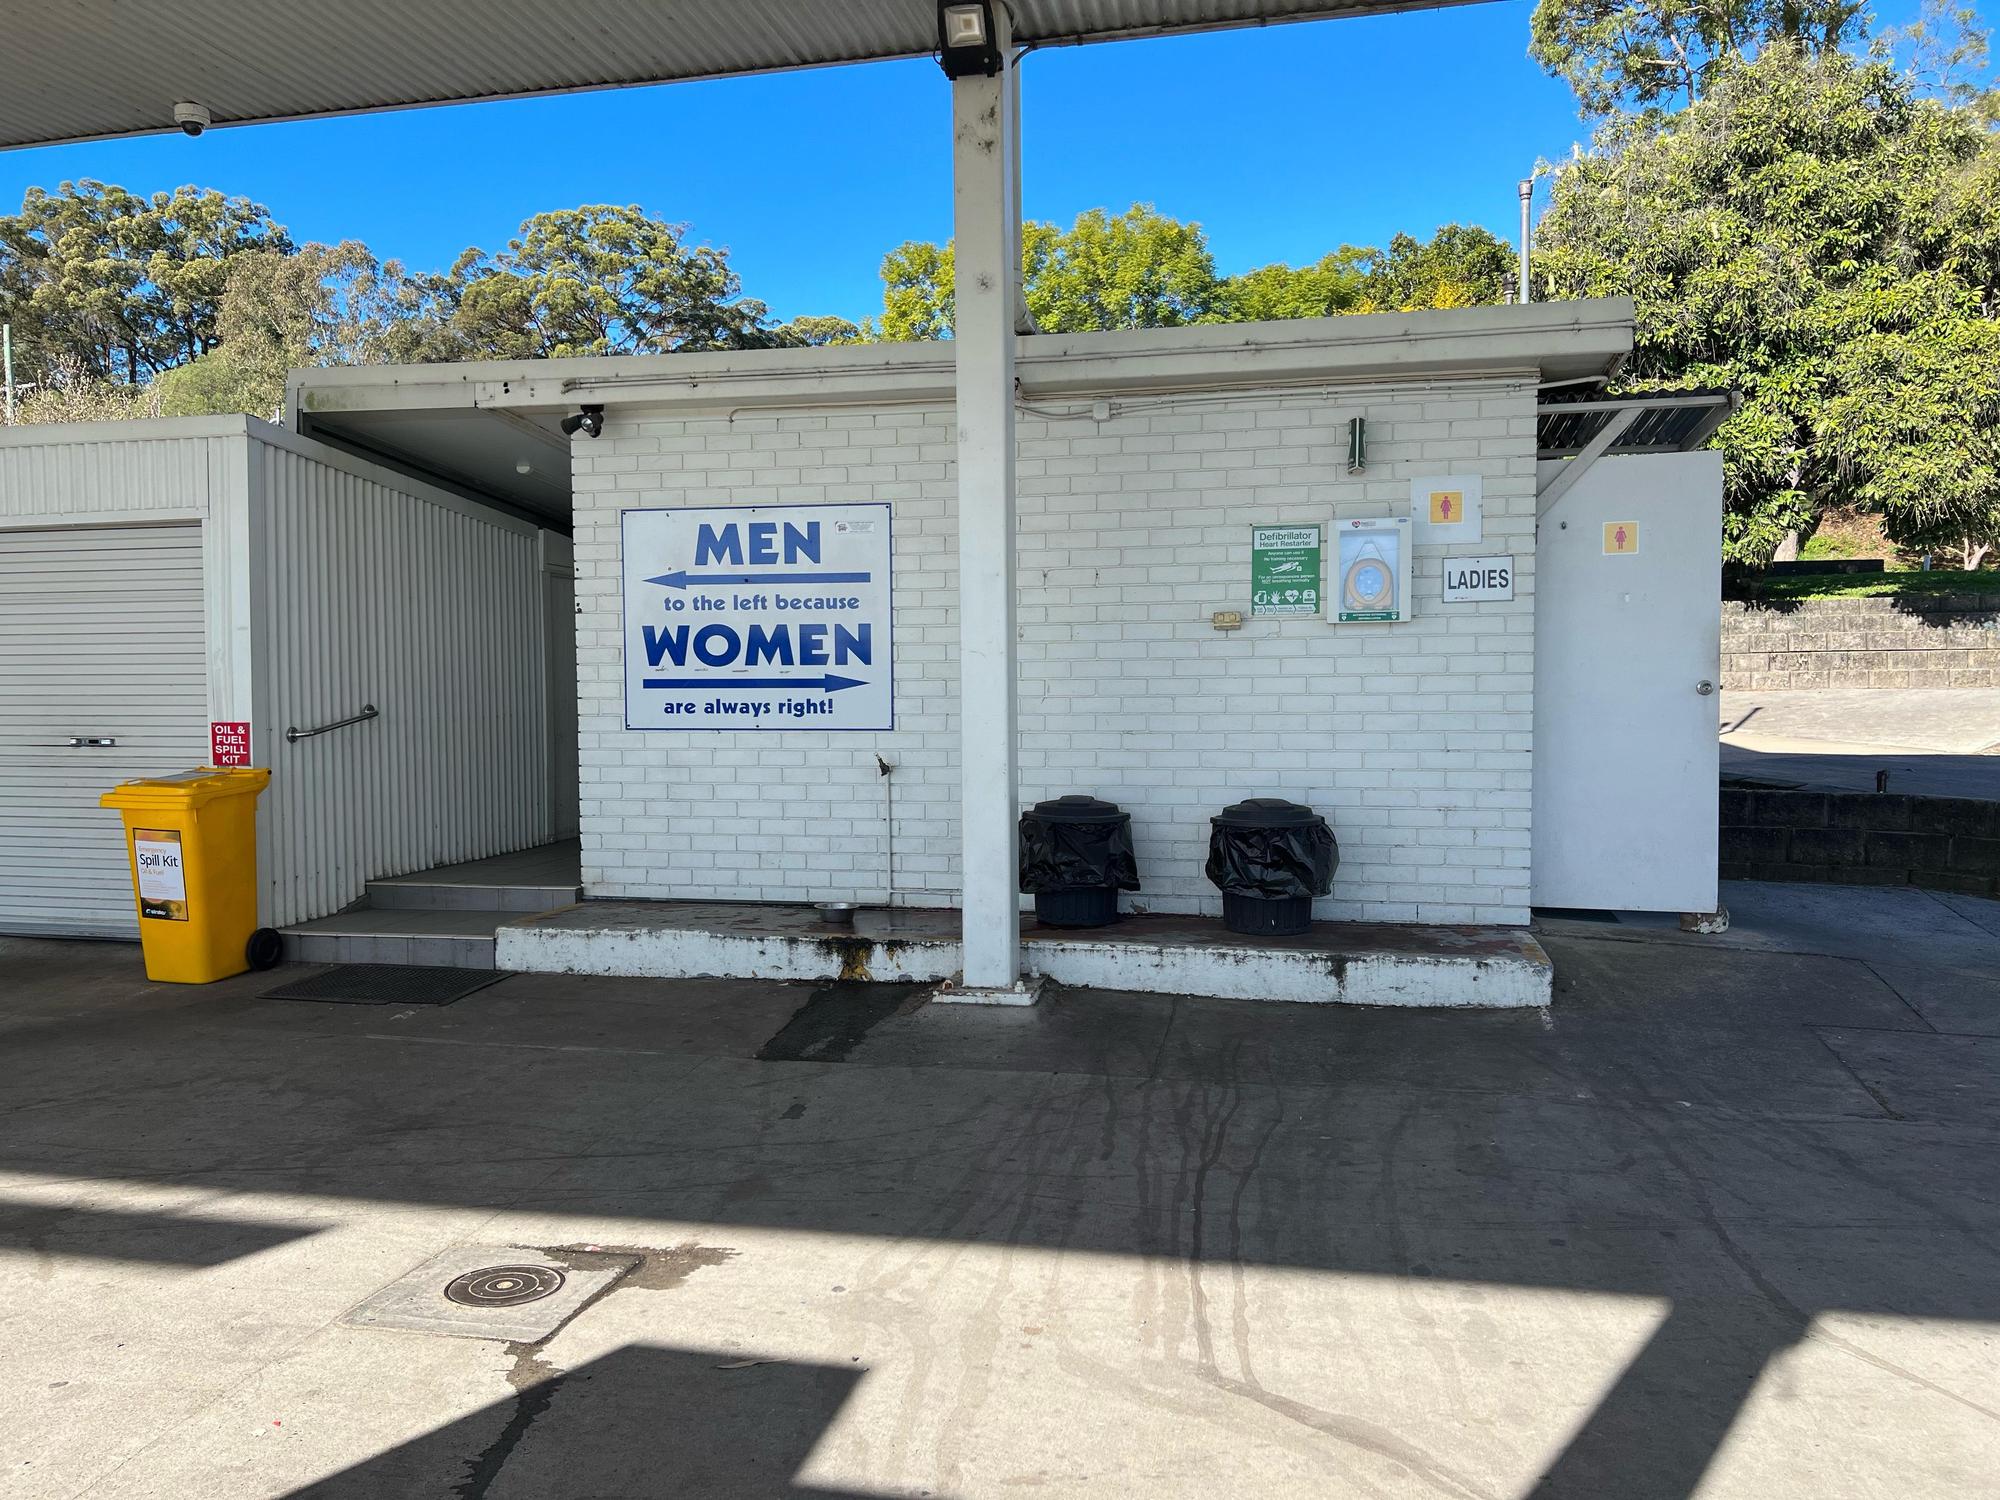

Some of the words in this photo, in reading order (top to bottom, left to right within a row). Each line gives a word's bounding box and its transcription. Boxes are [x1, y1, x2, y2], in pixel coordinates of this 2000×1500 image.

[1260, 531, 1311, 540] Defibrillator
[695, 521, 821, 566] MEN
[1448, 568, 1509, 590] LADIES
[664, 596, 685, 611] to
[693, 595, 725, 611] the
[733, 594, 768, 611] left
[775, 594, 860, 610] because
[642, 623, 872, 667] WOMEN
[664, 701, 696, 714] are
[704, 698, 771, 718] always
[778, 698, 833, 718] right!
[215, 725, 234, 734] OIL
[237, 725, 245, 734] &
[216, 735, 246, 744] FUEL
[215, 745, 247, 754] SPILL
[222, 755, 240, 764] KIT
[139, 853, 160, 868] Spill
[163, 855, 179, 867] Kit
